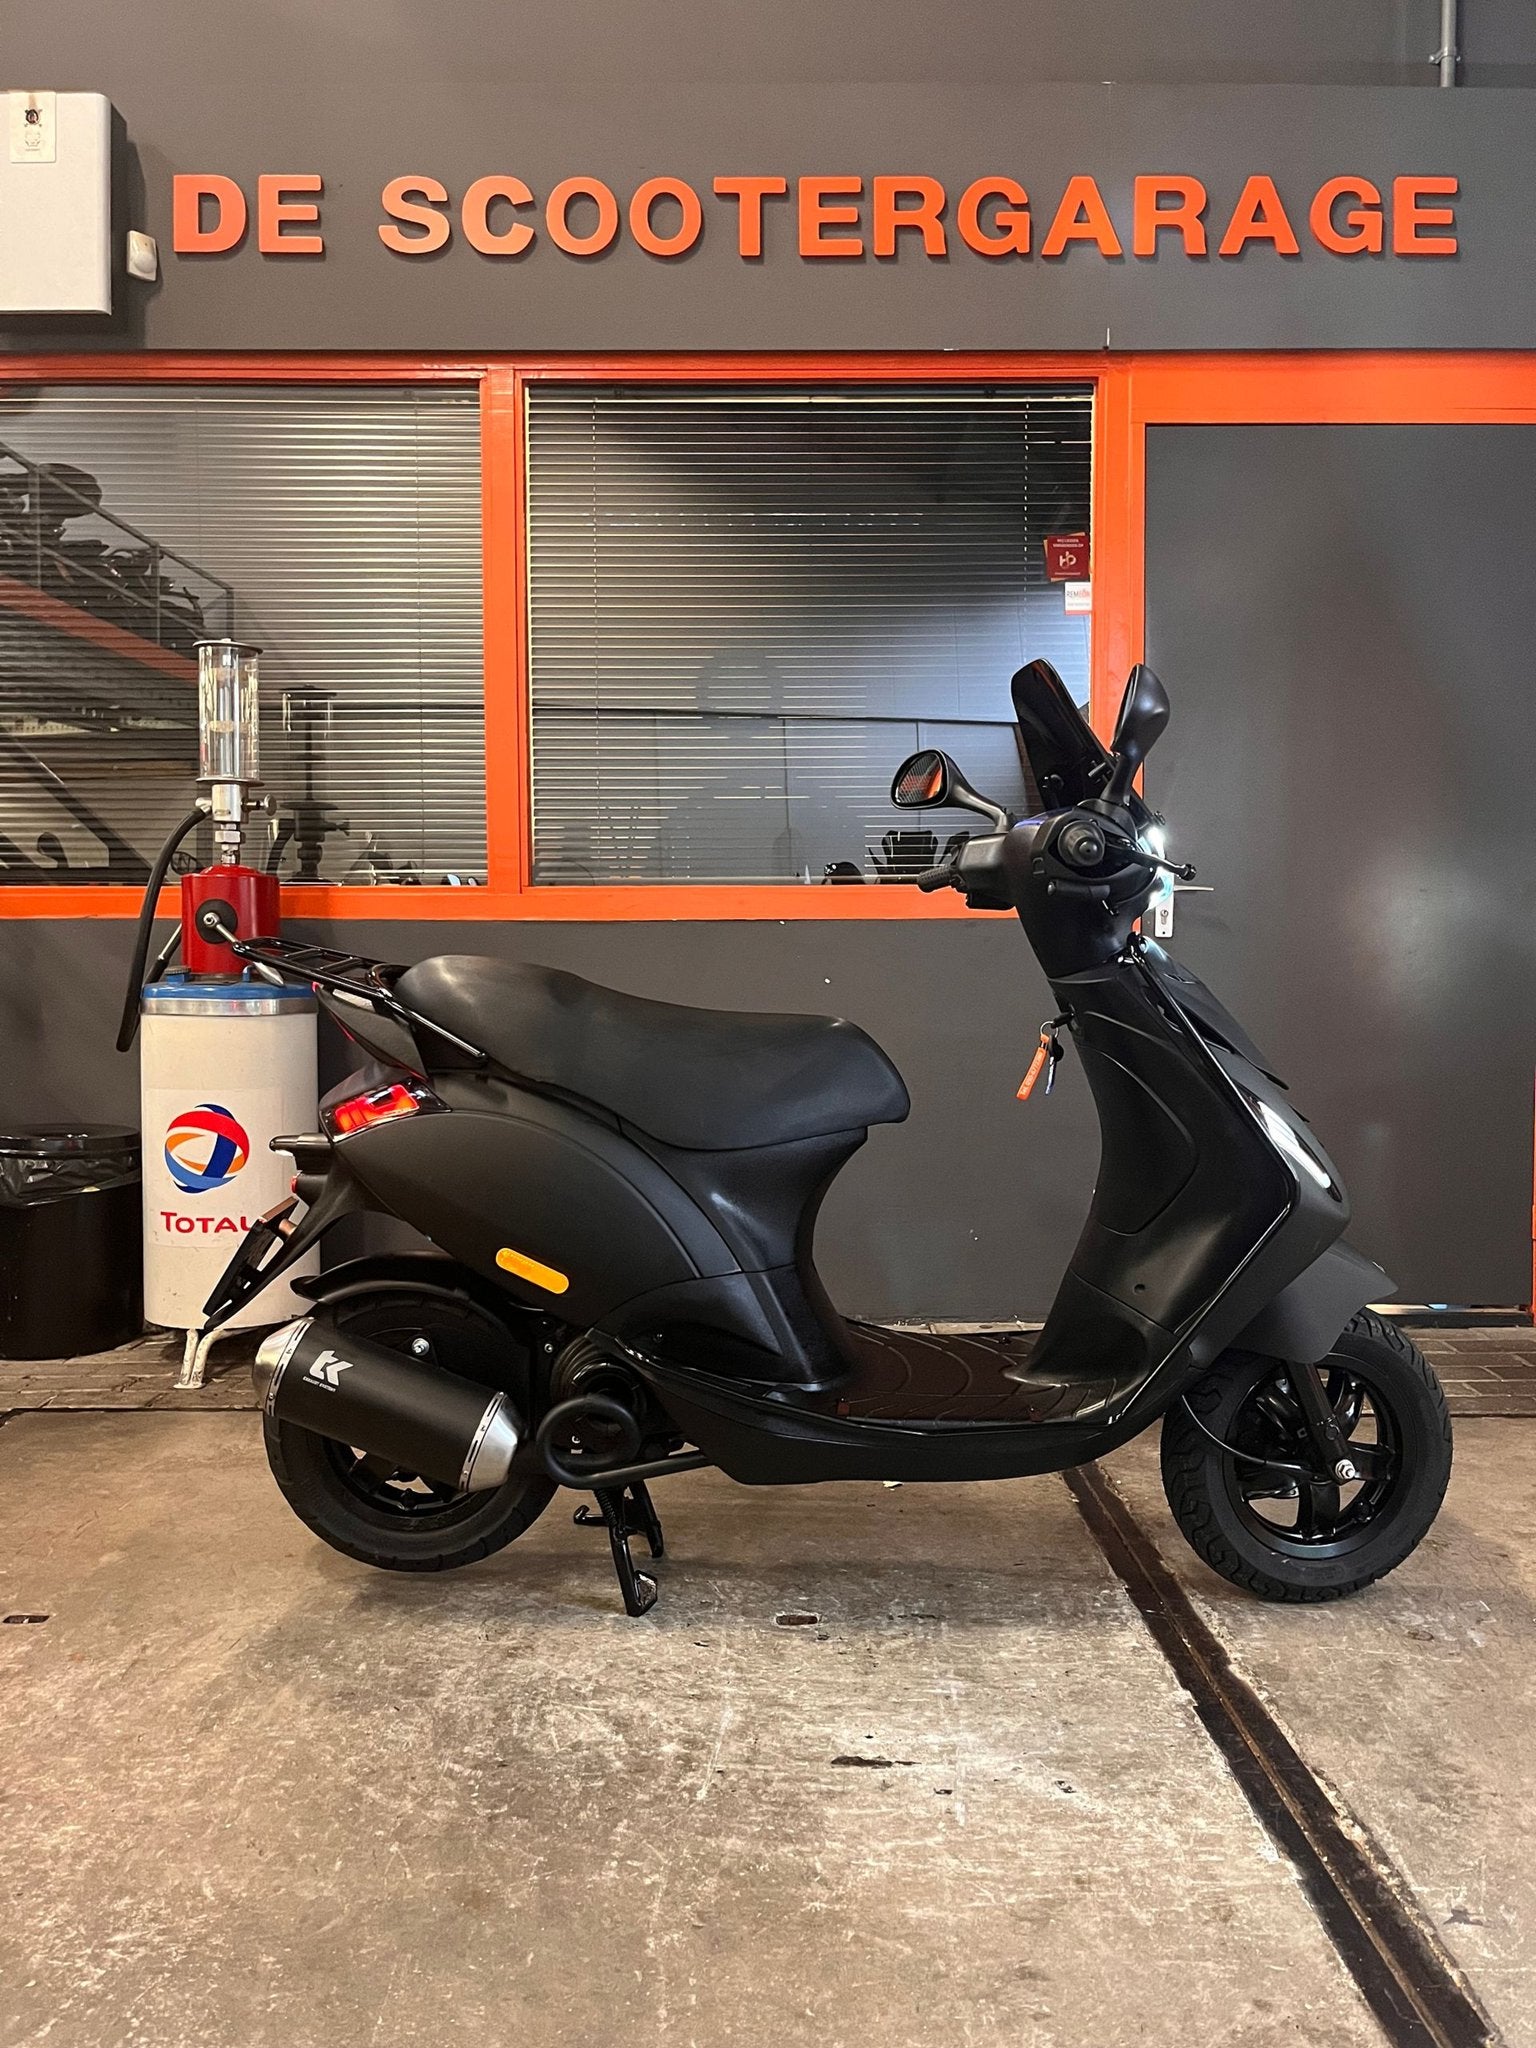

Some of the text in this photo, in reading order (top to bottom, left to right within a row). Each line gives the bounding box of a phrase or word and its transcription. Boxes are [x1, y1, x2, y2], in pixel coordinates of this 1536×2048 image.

[172, 174, 1458, 256] DE SCOOTERGARAGE
[160, 1211, 251, 1234] TOTAL
